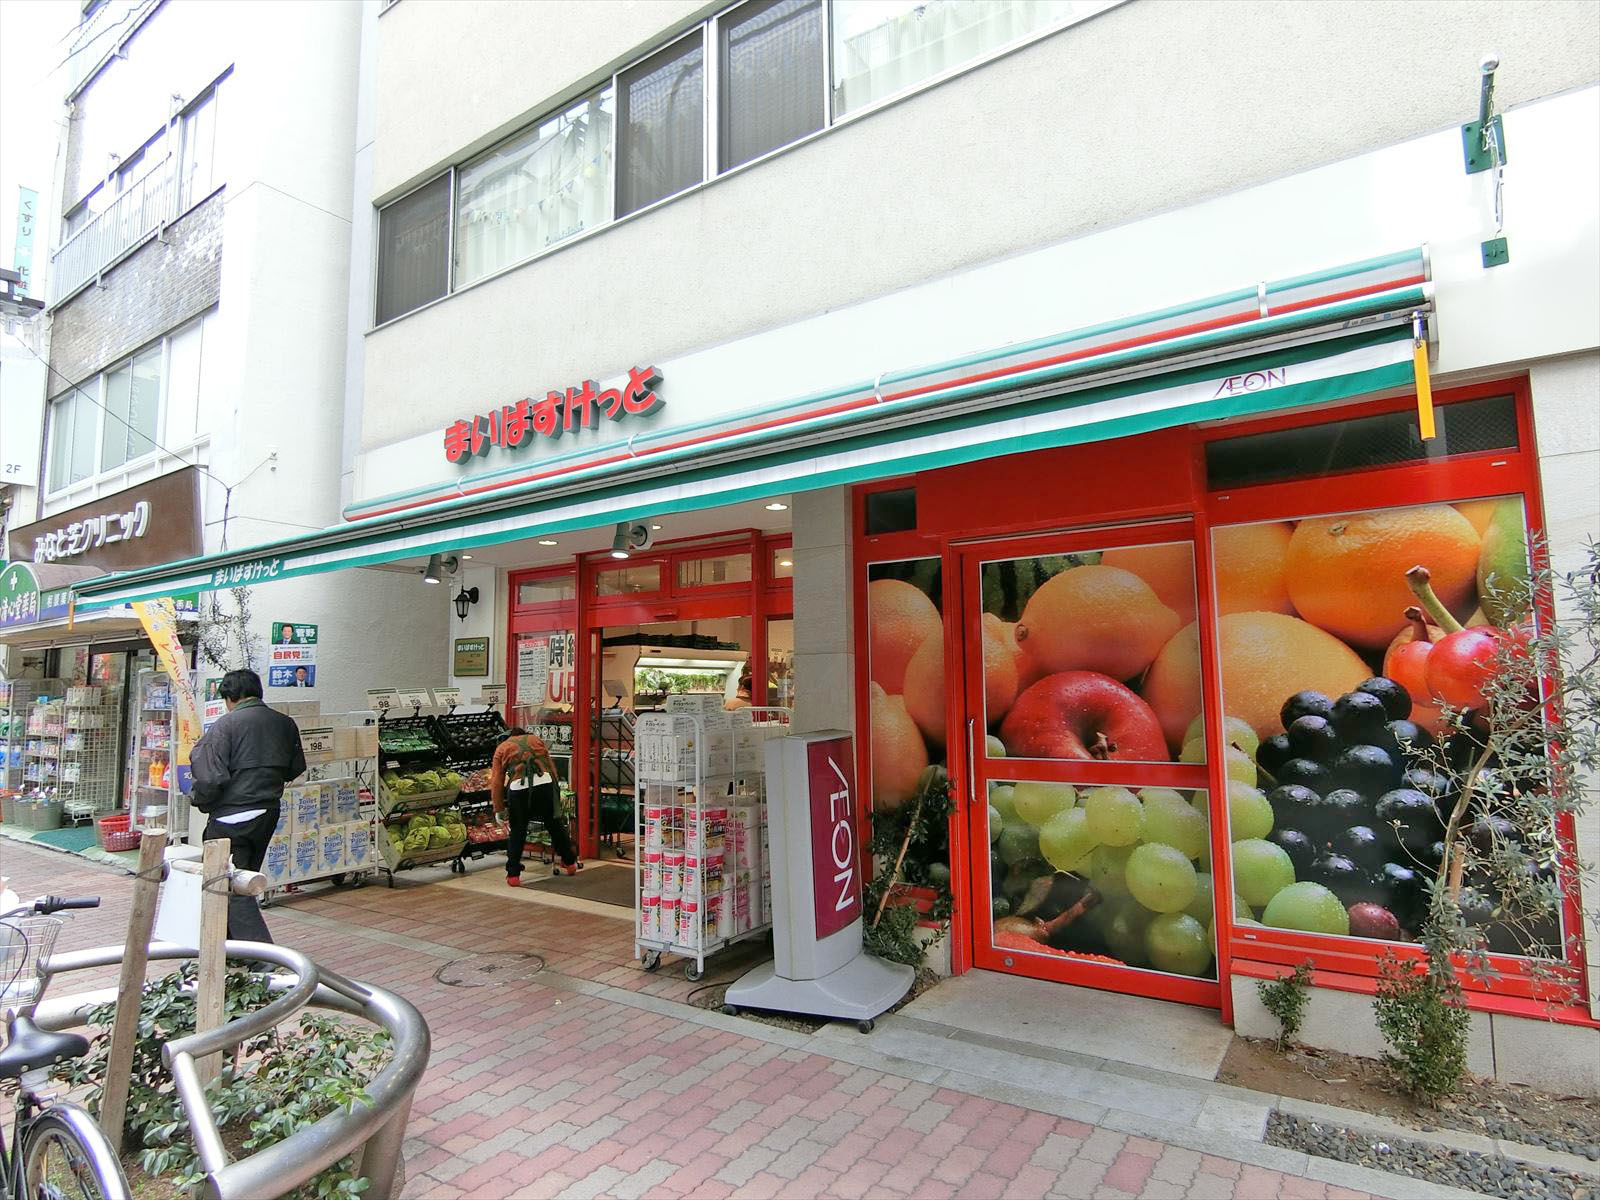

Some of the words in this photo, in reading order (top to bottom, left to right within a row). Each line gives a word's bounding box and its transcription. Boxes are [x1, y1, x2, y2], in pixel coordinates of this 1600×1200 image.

[22, 200, 33, 237] くすり
[444, 365, 665, 465] まいばすけっと
[5, 463, 22, 475] 2F
[34, 501, 152, 564] みなと芝クリニック
[214, 558, 280, 587] まいばすけっと
[273, 651, 301, 659] 自民党
[272, 670, 293, 679] 鈴木
[378, 700, 390, 709] 98
[310, 741, 323, 751] 198
[298, 797, 318, 805] Toilet
[298, 804, 318, 812] Paper
[268, 844, 288, 852] Toilet
[268, 851, 289, 859] Paper
